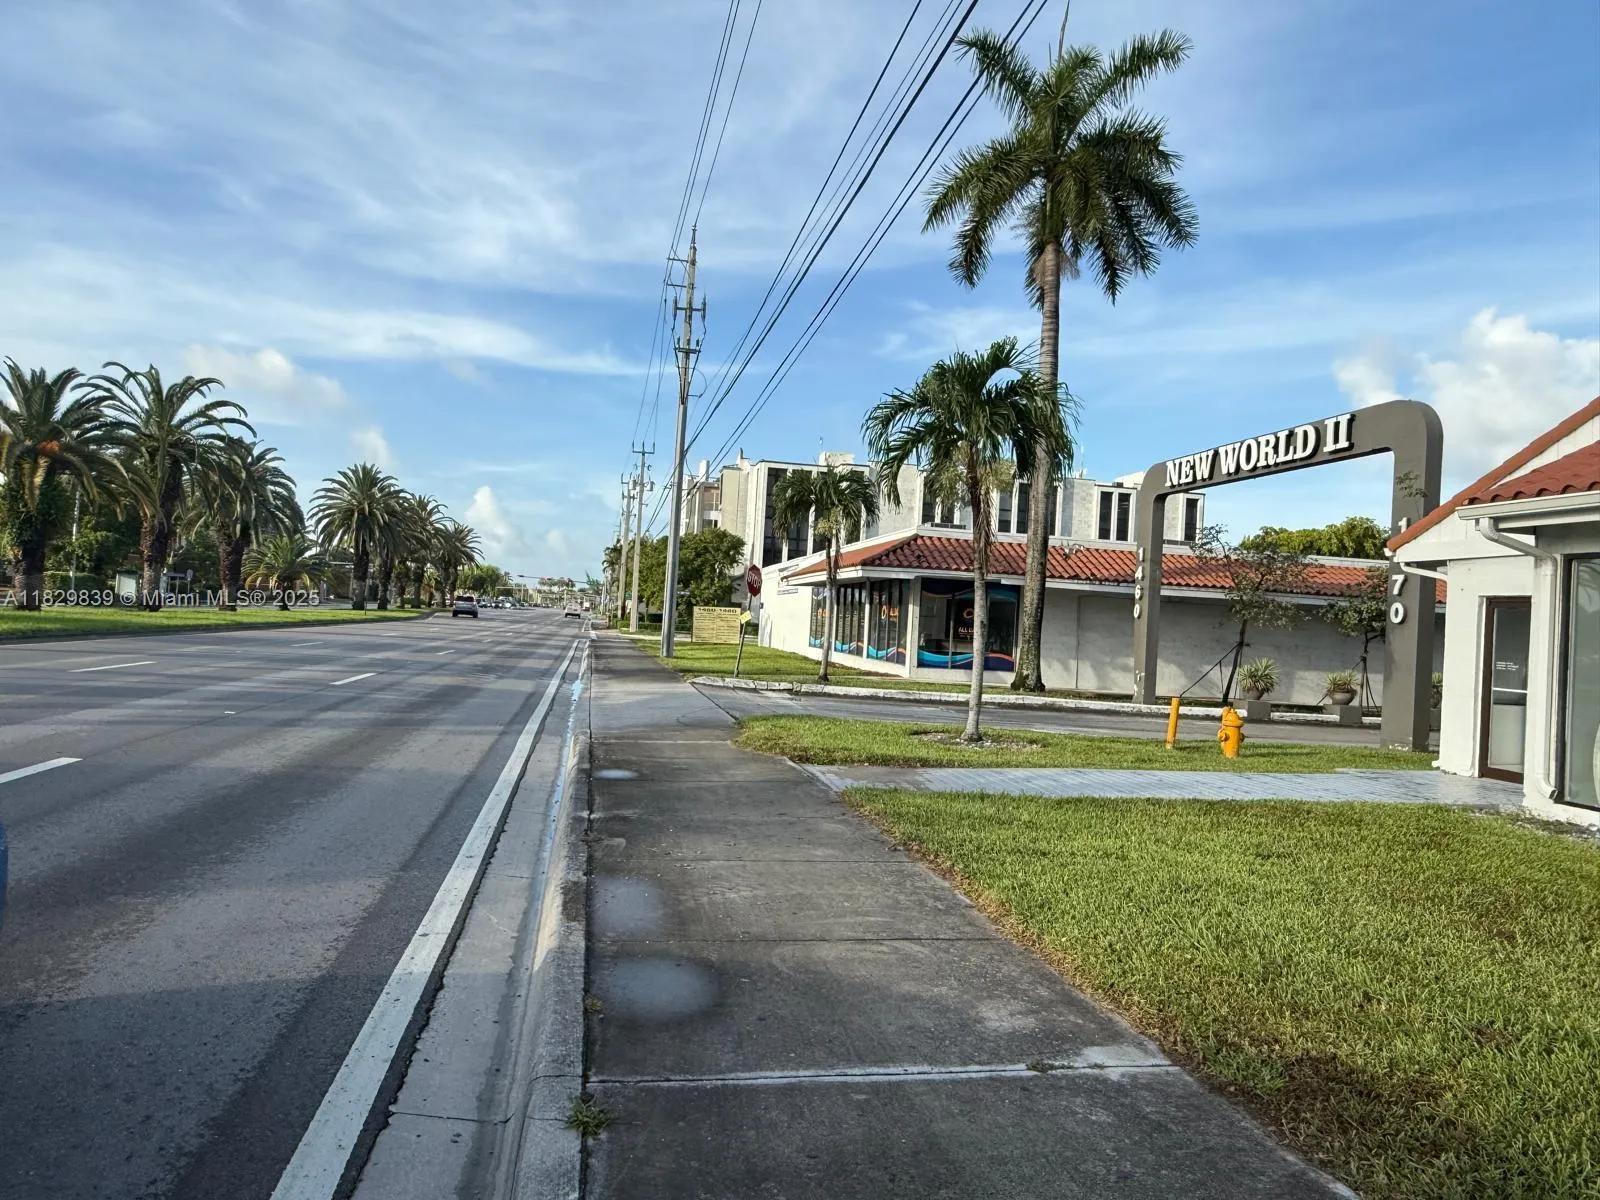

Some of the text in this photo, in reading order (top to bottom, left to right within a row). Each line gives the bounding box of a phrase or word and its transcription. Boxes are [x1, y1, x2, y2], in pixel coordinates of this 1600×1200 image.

[1165, 413, 1352, 488] NEW WORLD II
[748, 571, 762, 588] STOP
[1134, 547, 1144, 619] 1460
[1390, 517, 1408, 624] 170
